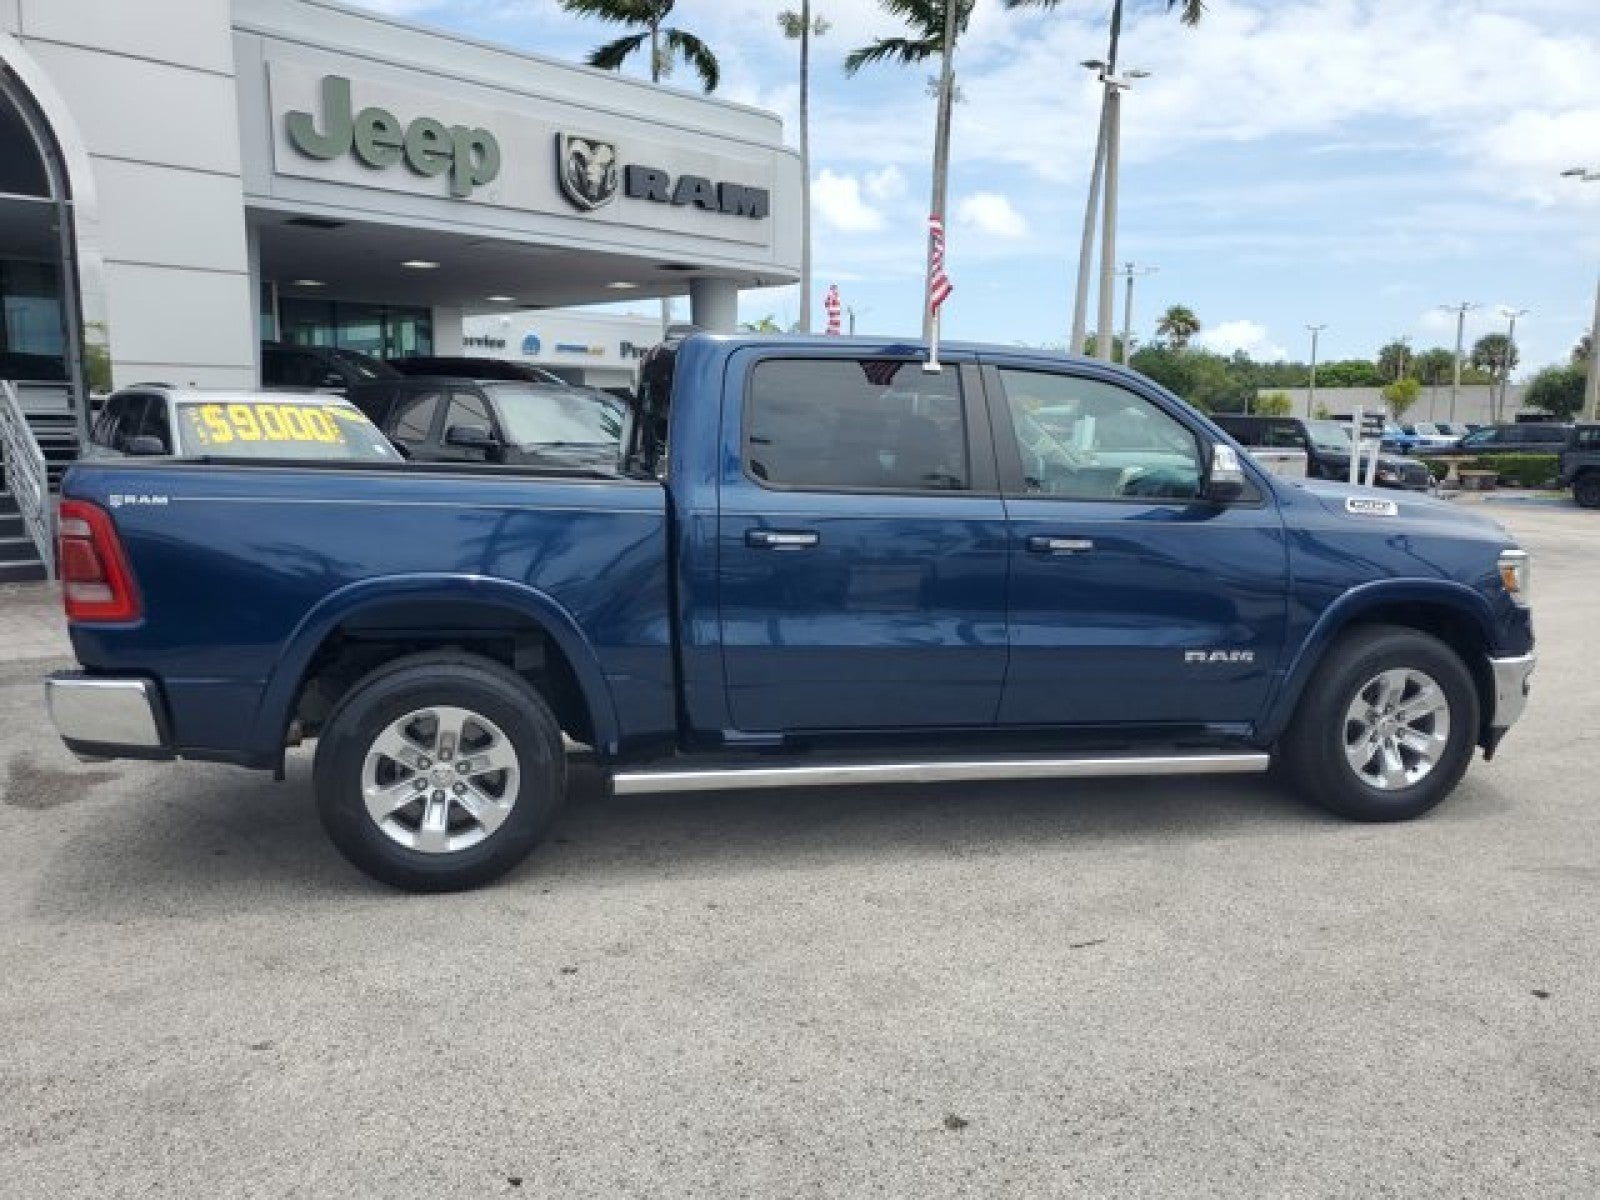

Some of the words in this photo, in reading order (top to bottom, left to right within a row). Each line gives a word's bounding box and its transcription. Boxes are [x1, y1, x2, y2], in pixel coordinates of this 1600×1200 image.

[284, 75, 500, 197] Jeep
[624, 165, 769, 219] RAM
[124, 495, 168, 505] RAM
[1184, 650, 1254, 663] RAM
